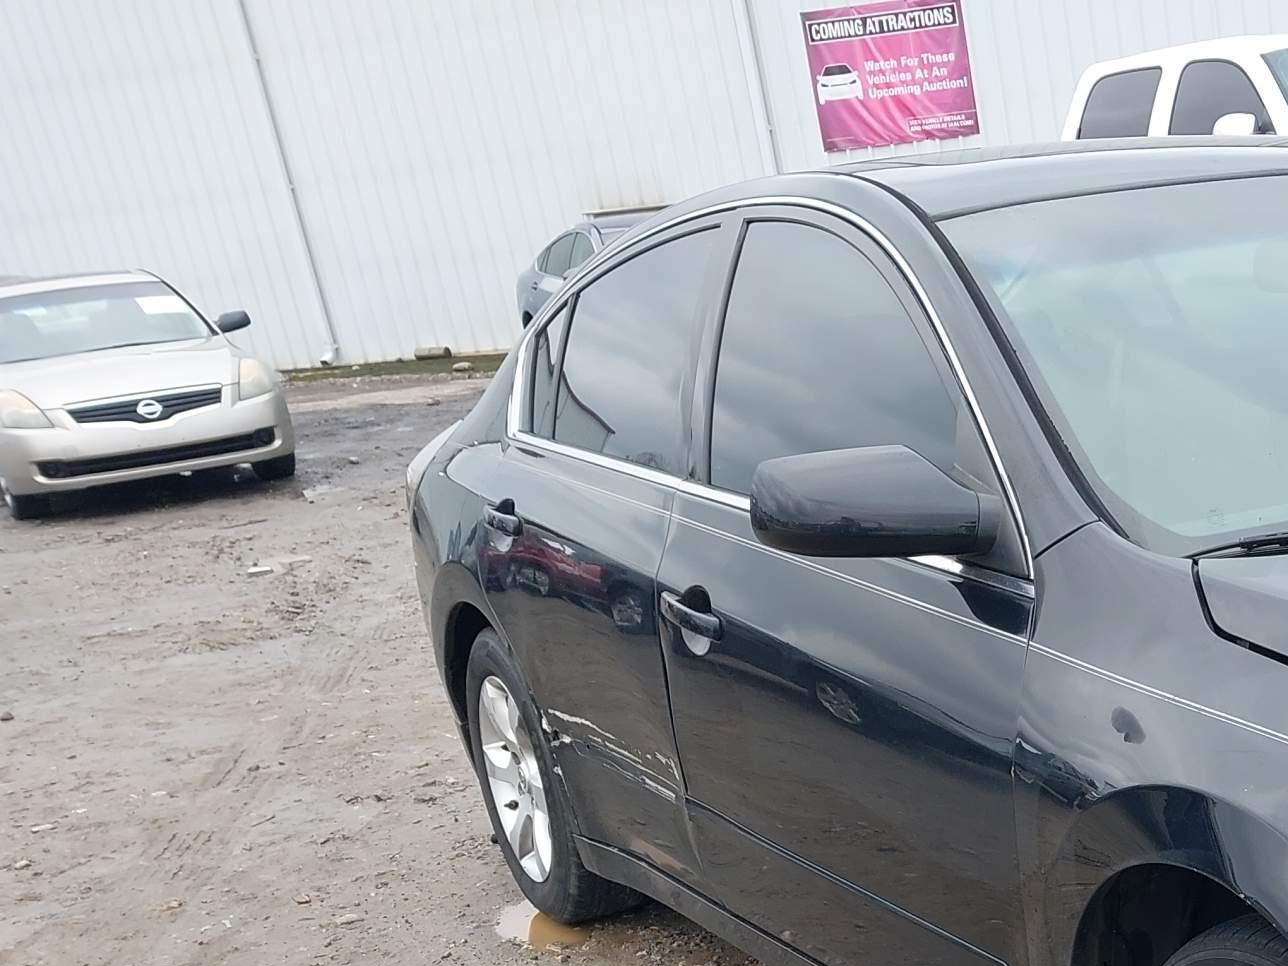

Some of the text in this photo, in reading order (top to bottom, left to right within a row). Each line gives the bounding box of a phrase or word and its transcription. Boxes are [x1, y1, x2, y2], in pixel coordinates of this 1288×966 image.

[811, 7, 953, 40] COMING ATTRACTIONS
[864, 53, 955, 72] Watch For These
[866, 66, 948, 85] Vehicles At An
[868, 76, 968, 99] Upcoming Auction!
